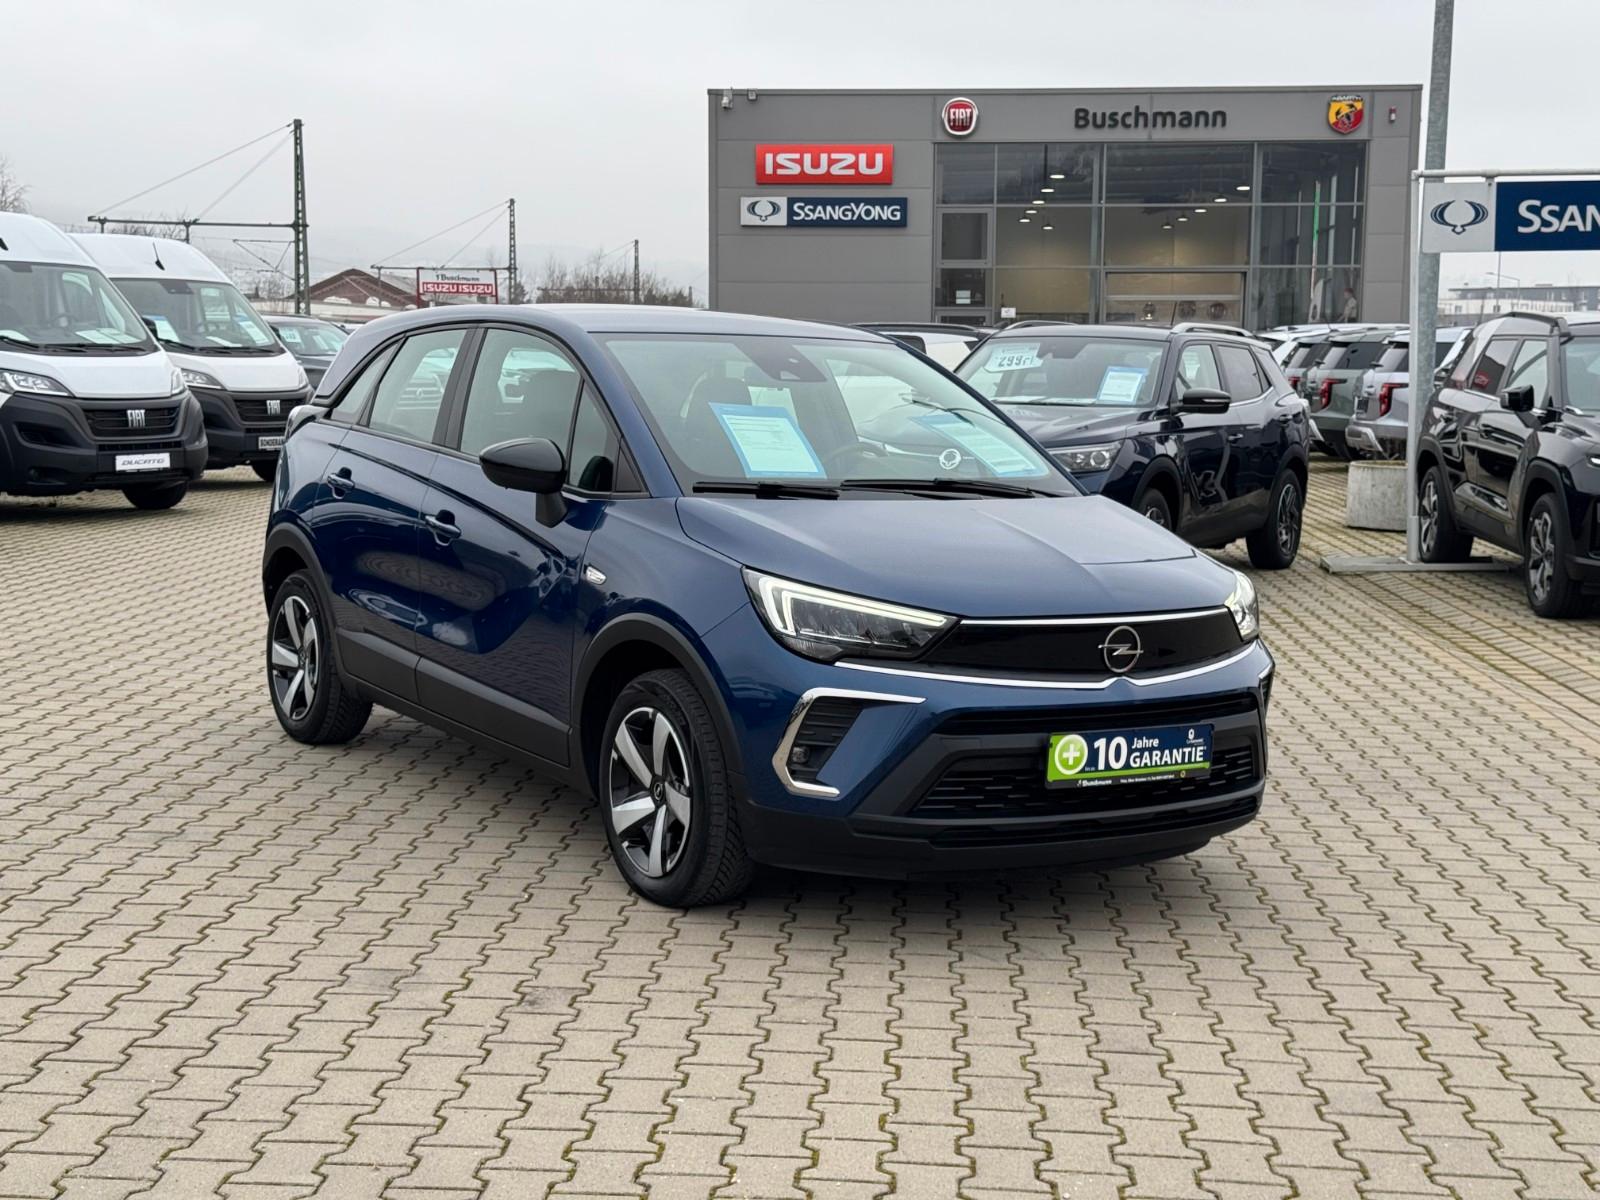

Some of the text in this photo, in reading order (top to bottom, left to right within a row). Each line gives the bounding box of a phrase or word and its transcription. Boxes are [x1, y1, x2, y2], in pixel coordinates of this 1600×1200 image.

[949, 108, 972, 126] FIAT
[1073, 106, 1227, 129] Buschmann
[765, 153, 884, 175] ISUZU
[423, 283, 492, 293] ISUZU ISUZU
[266, 400, 281, 415] FIAT
[127, 409, 146, 427] FIAT
[121, 458, 165, 466] DUCATO
[1132, 736, 1159, 749] Jahre
[1094, 736, 1128, 770] 10
